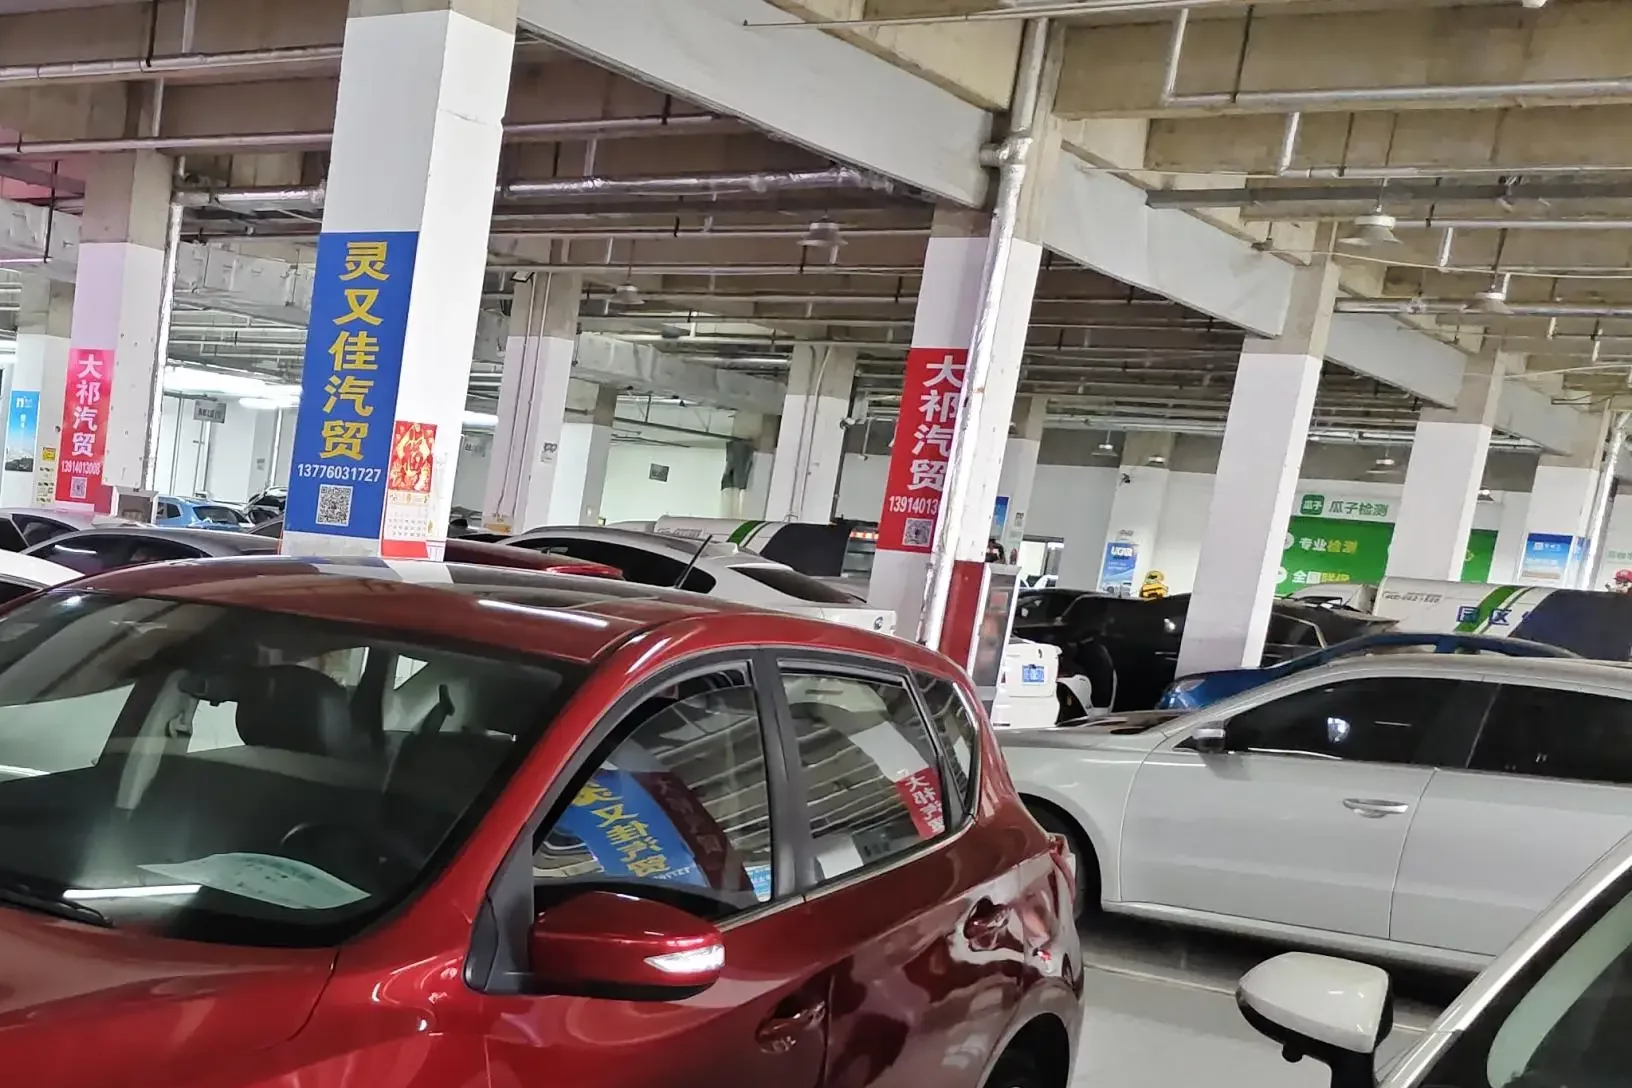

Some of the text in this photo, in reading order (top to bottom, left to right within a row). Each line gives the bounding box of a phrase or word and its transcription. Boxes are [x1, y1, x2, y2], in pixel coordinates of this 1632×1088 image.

[319, 241, 389, 461] 灵又佳汽贸
[71, 353, 104, 458] 大祁汽贸
[907, 354, 967, 491] 大祁汽贸
[297, 463, 382, 483] 13776031727
[888, 495, 939, 516] 13914013
